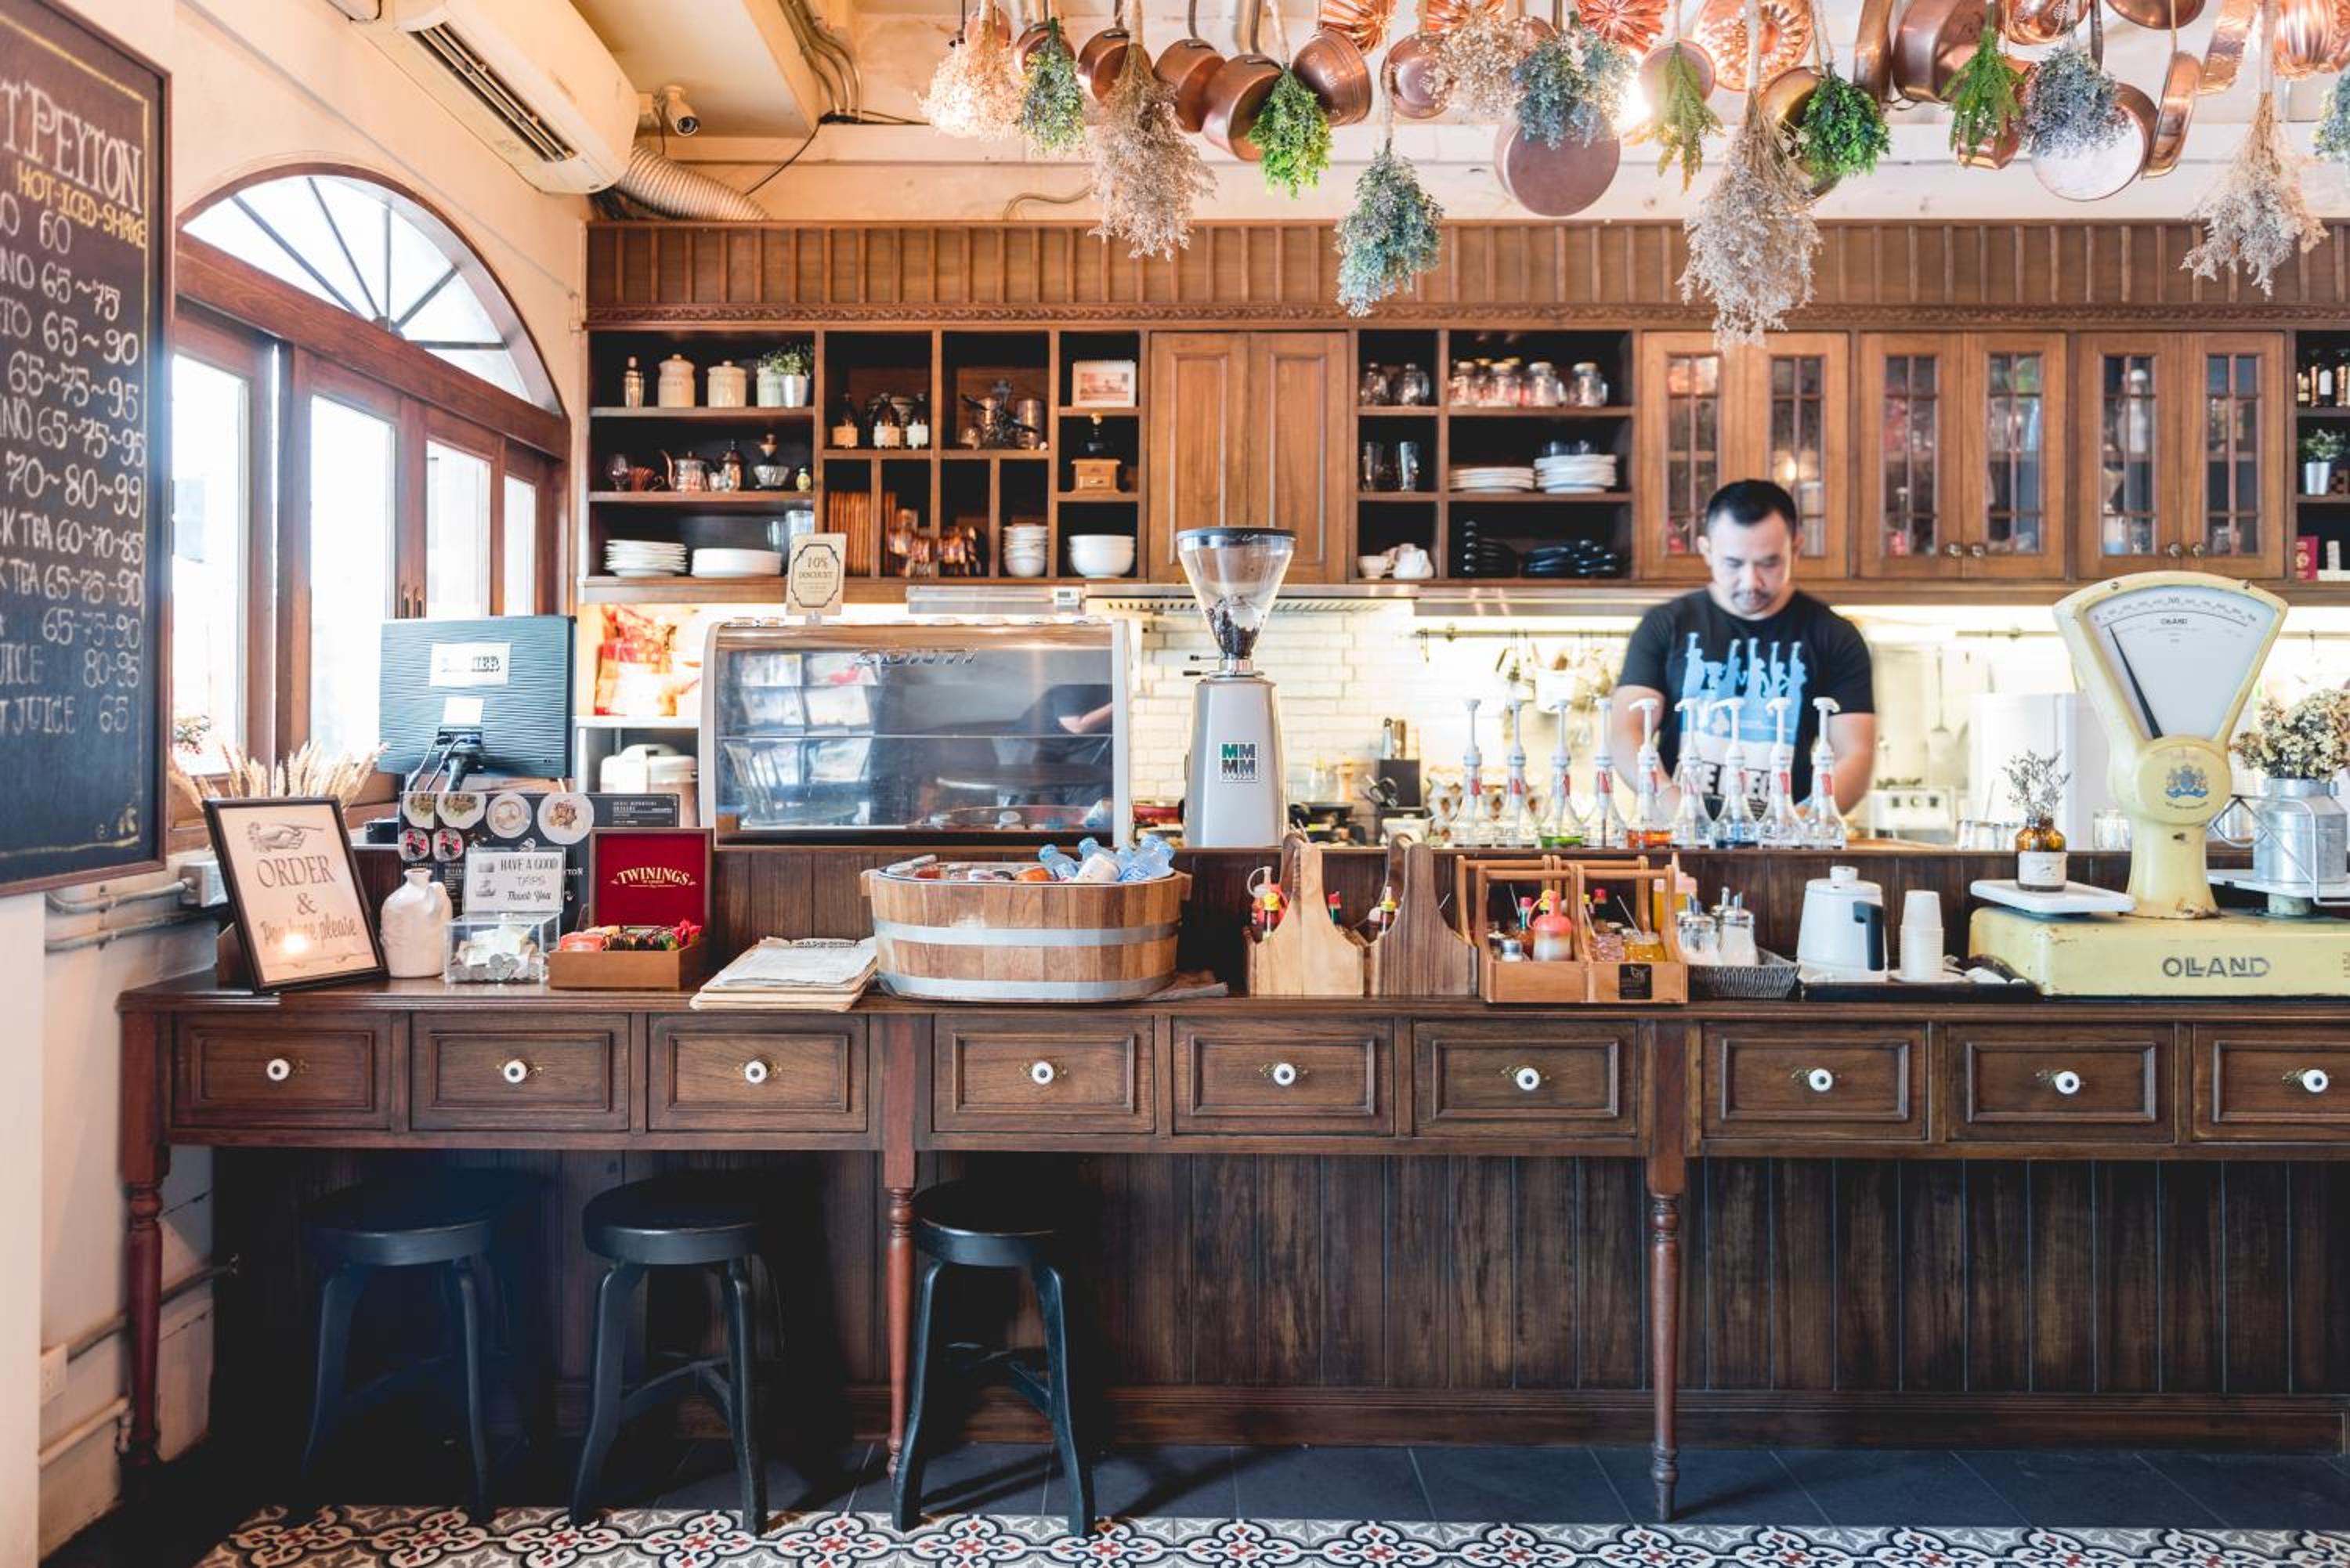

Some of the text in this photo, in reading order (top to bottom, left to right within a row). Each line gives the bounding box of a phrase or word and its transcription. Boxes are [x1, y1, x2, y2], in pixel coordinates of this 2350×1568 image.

[24, 80, 142, 214] PEYTON
[39, 210, 71, 255] 60
[256, 854, 336, 888] ORDER
[501, 857, 559, 872] HAVE A GOOD
[616, 866, 691, 886] TWININGS
[297, 892, 317, 915] &
